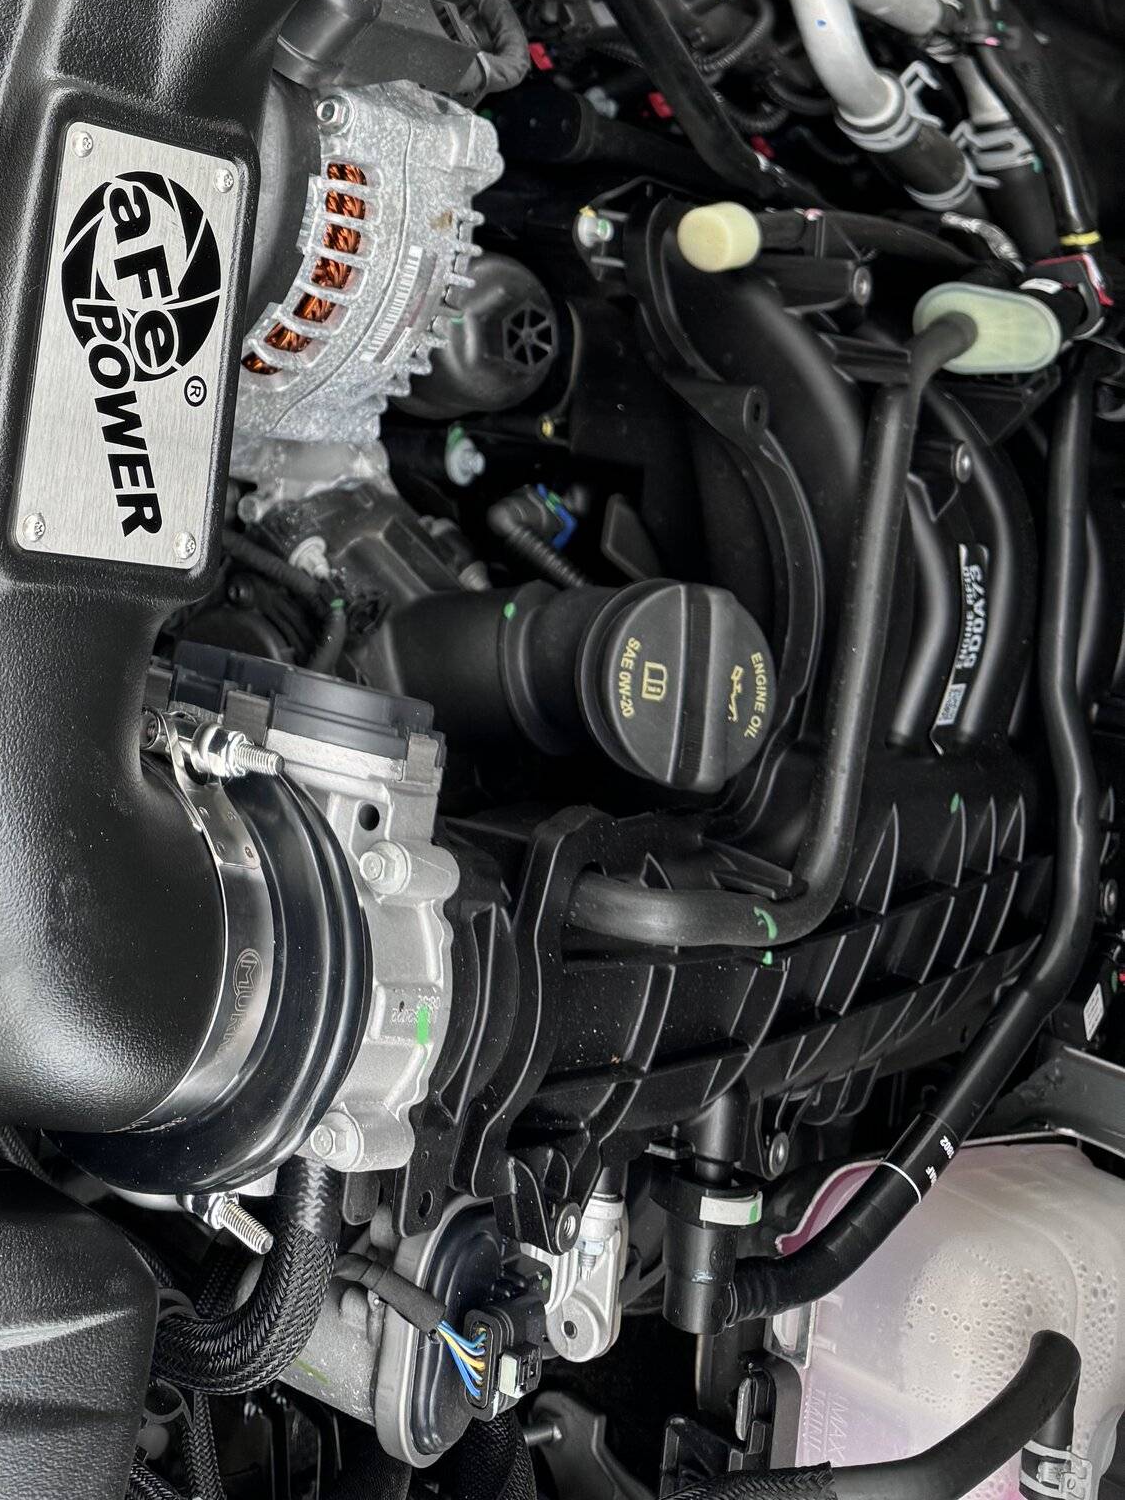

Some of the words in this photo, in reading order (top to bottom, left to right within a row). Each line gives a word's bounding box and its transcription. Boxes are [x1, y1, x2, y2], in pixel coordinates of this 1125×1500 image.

[108, 186, 179, 370] aFe
[77, 303, 163, 538] POWER
[620, 637, 642, 670] SAE
[750, 652, 767, 713] ENGINE
[618, 671, 635, 718] 0W-20
[743, 715, 762, 740] OIL
[827, 1401, 847, 1461] MAX
